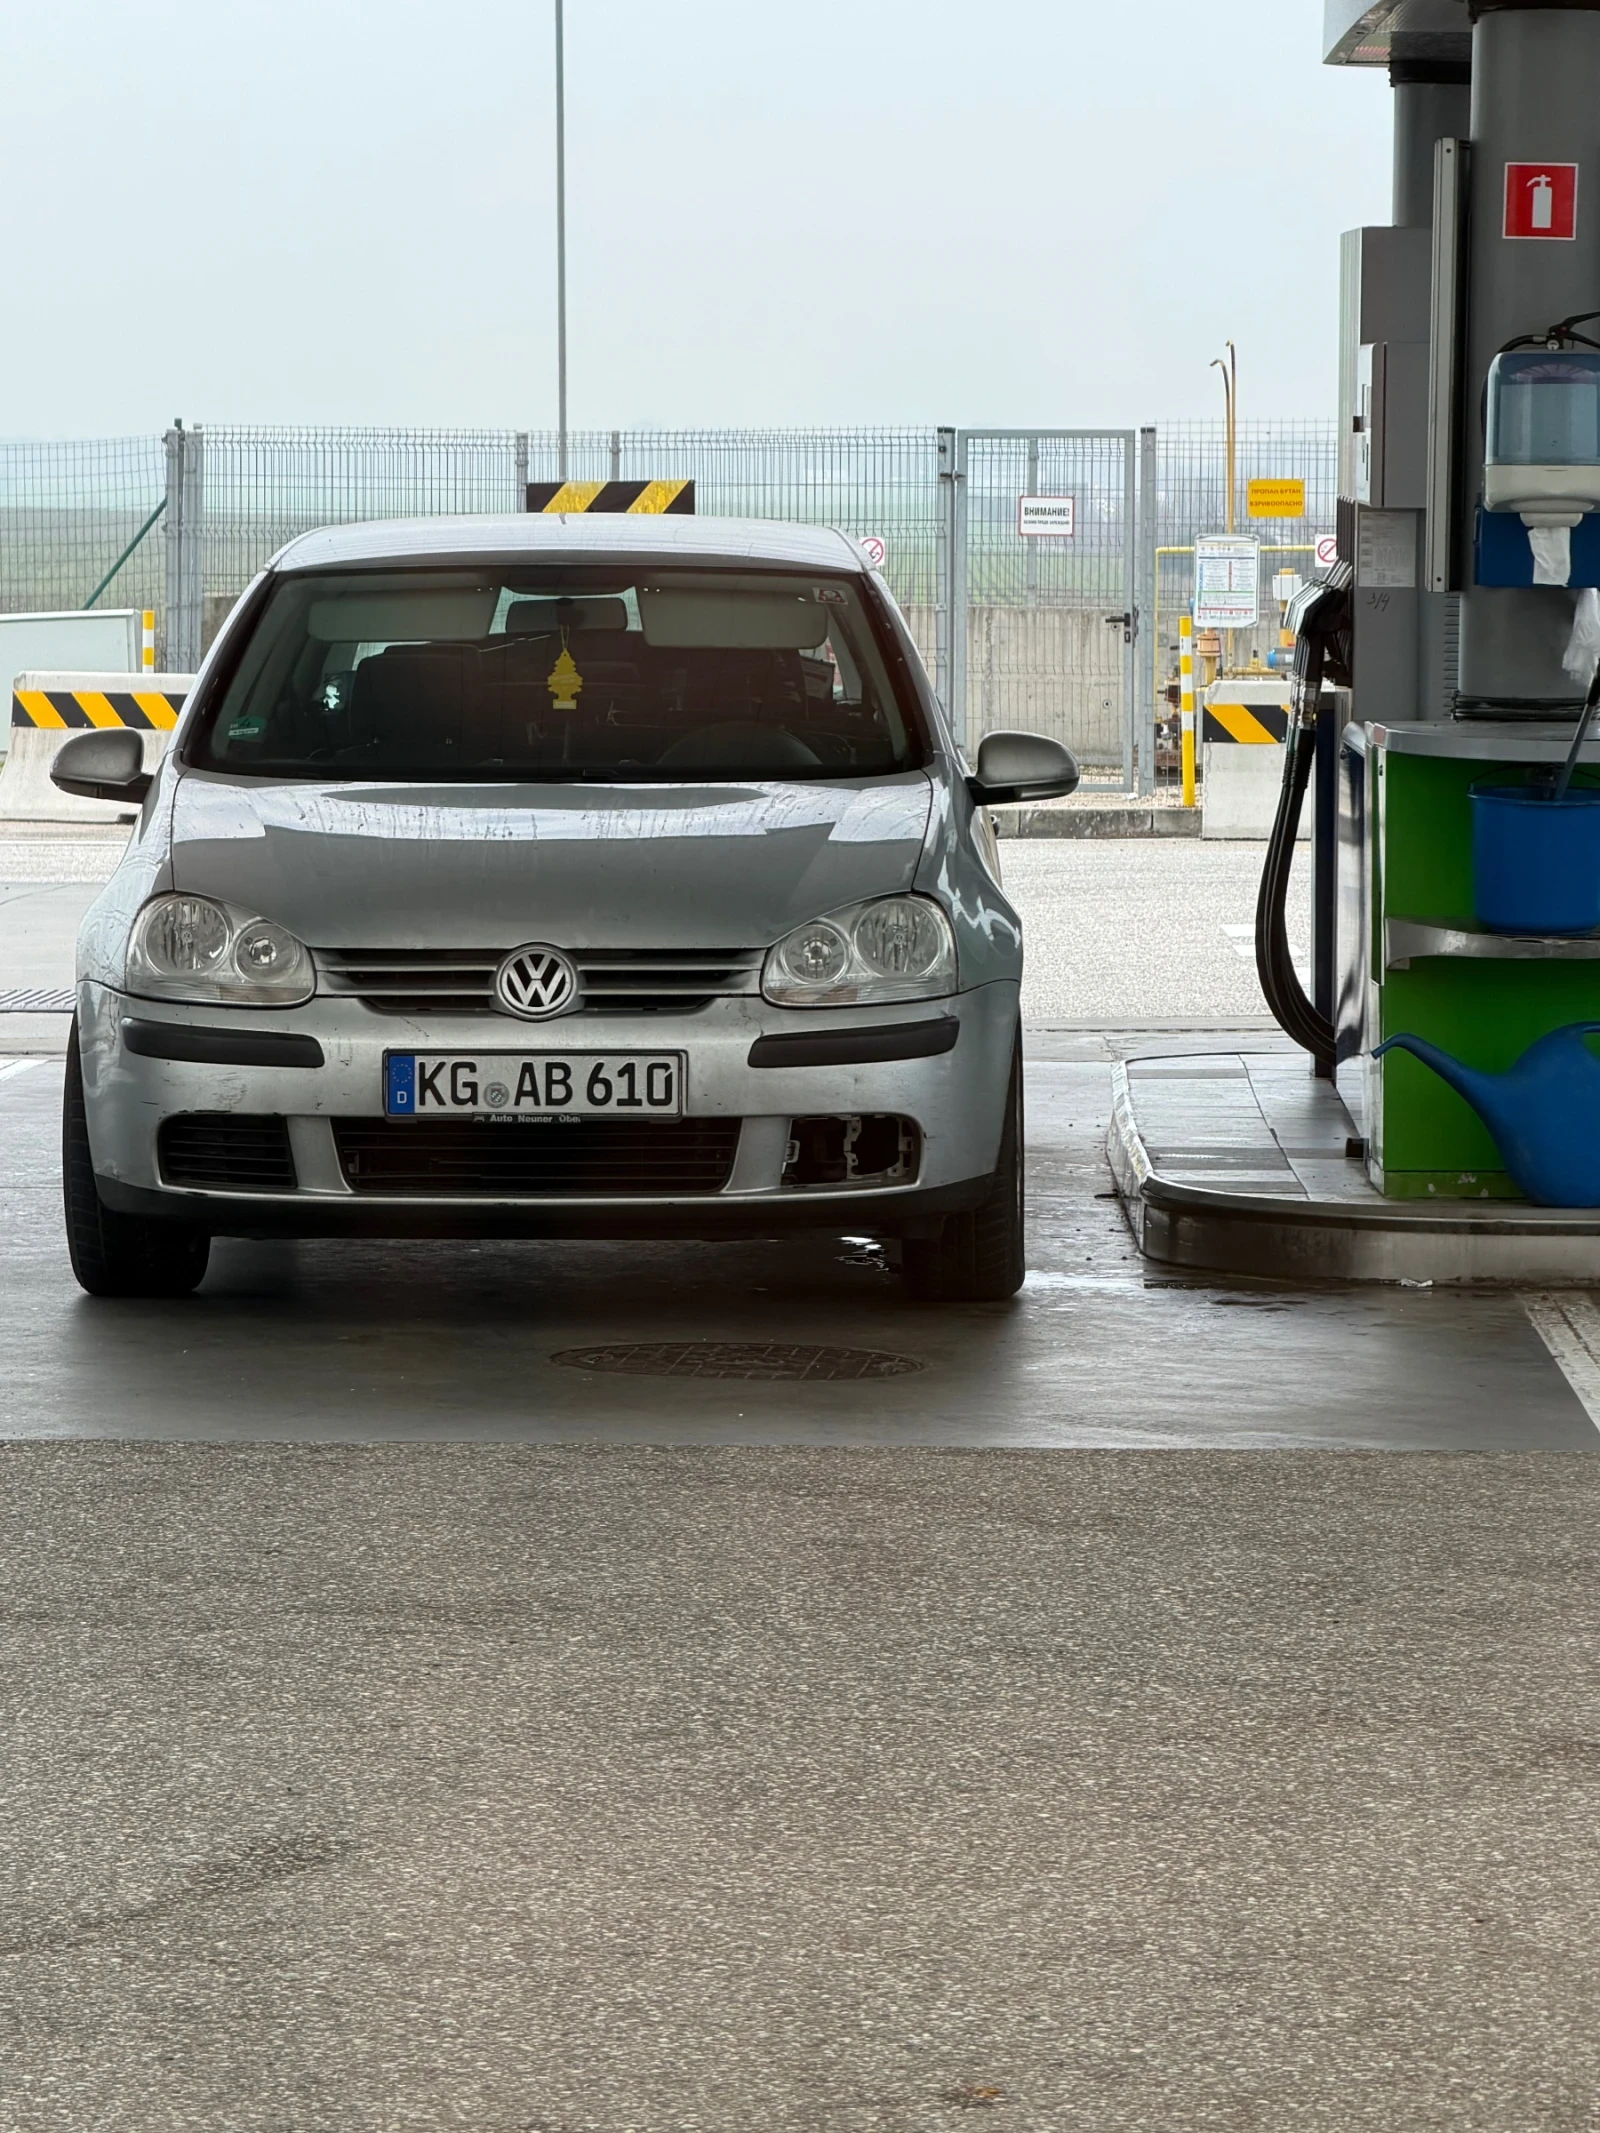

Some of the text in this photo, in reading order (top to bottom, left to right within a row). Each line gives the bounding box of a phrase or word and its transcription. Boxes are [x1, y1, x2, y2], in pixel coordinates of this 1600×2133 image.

[1024, 506, 1070, 517] ВНИМАНИЕ!
[418, 1061, 479, 1106] KG
[514, 1061, 573, 1107] AB
[586, 1061, 673, 1107] 610
[396, 1090, 408, 1104] D
[489, 1114, 513, 1123] Auto
[517, 1114, 553, 1123] Neuner
